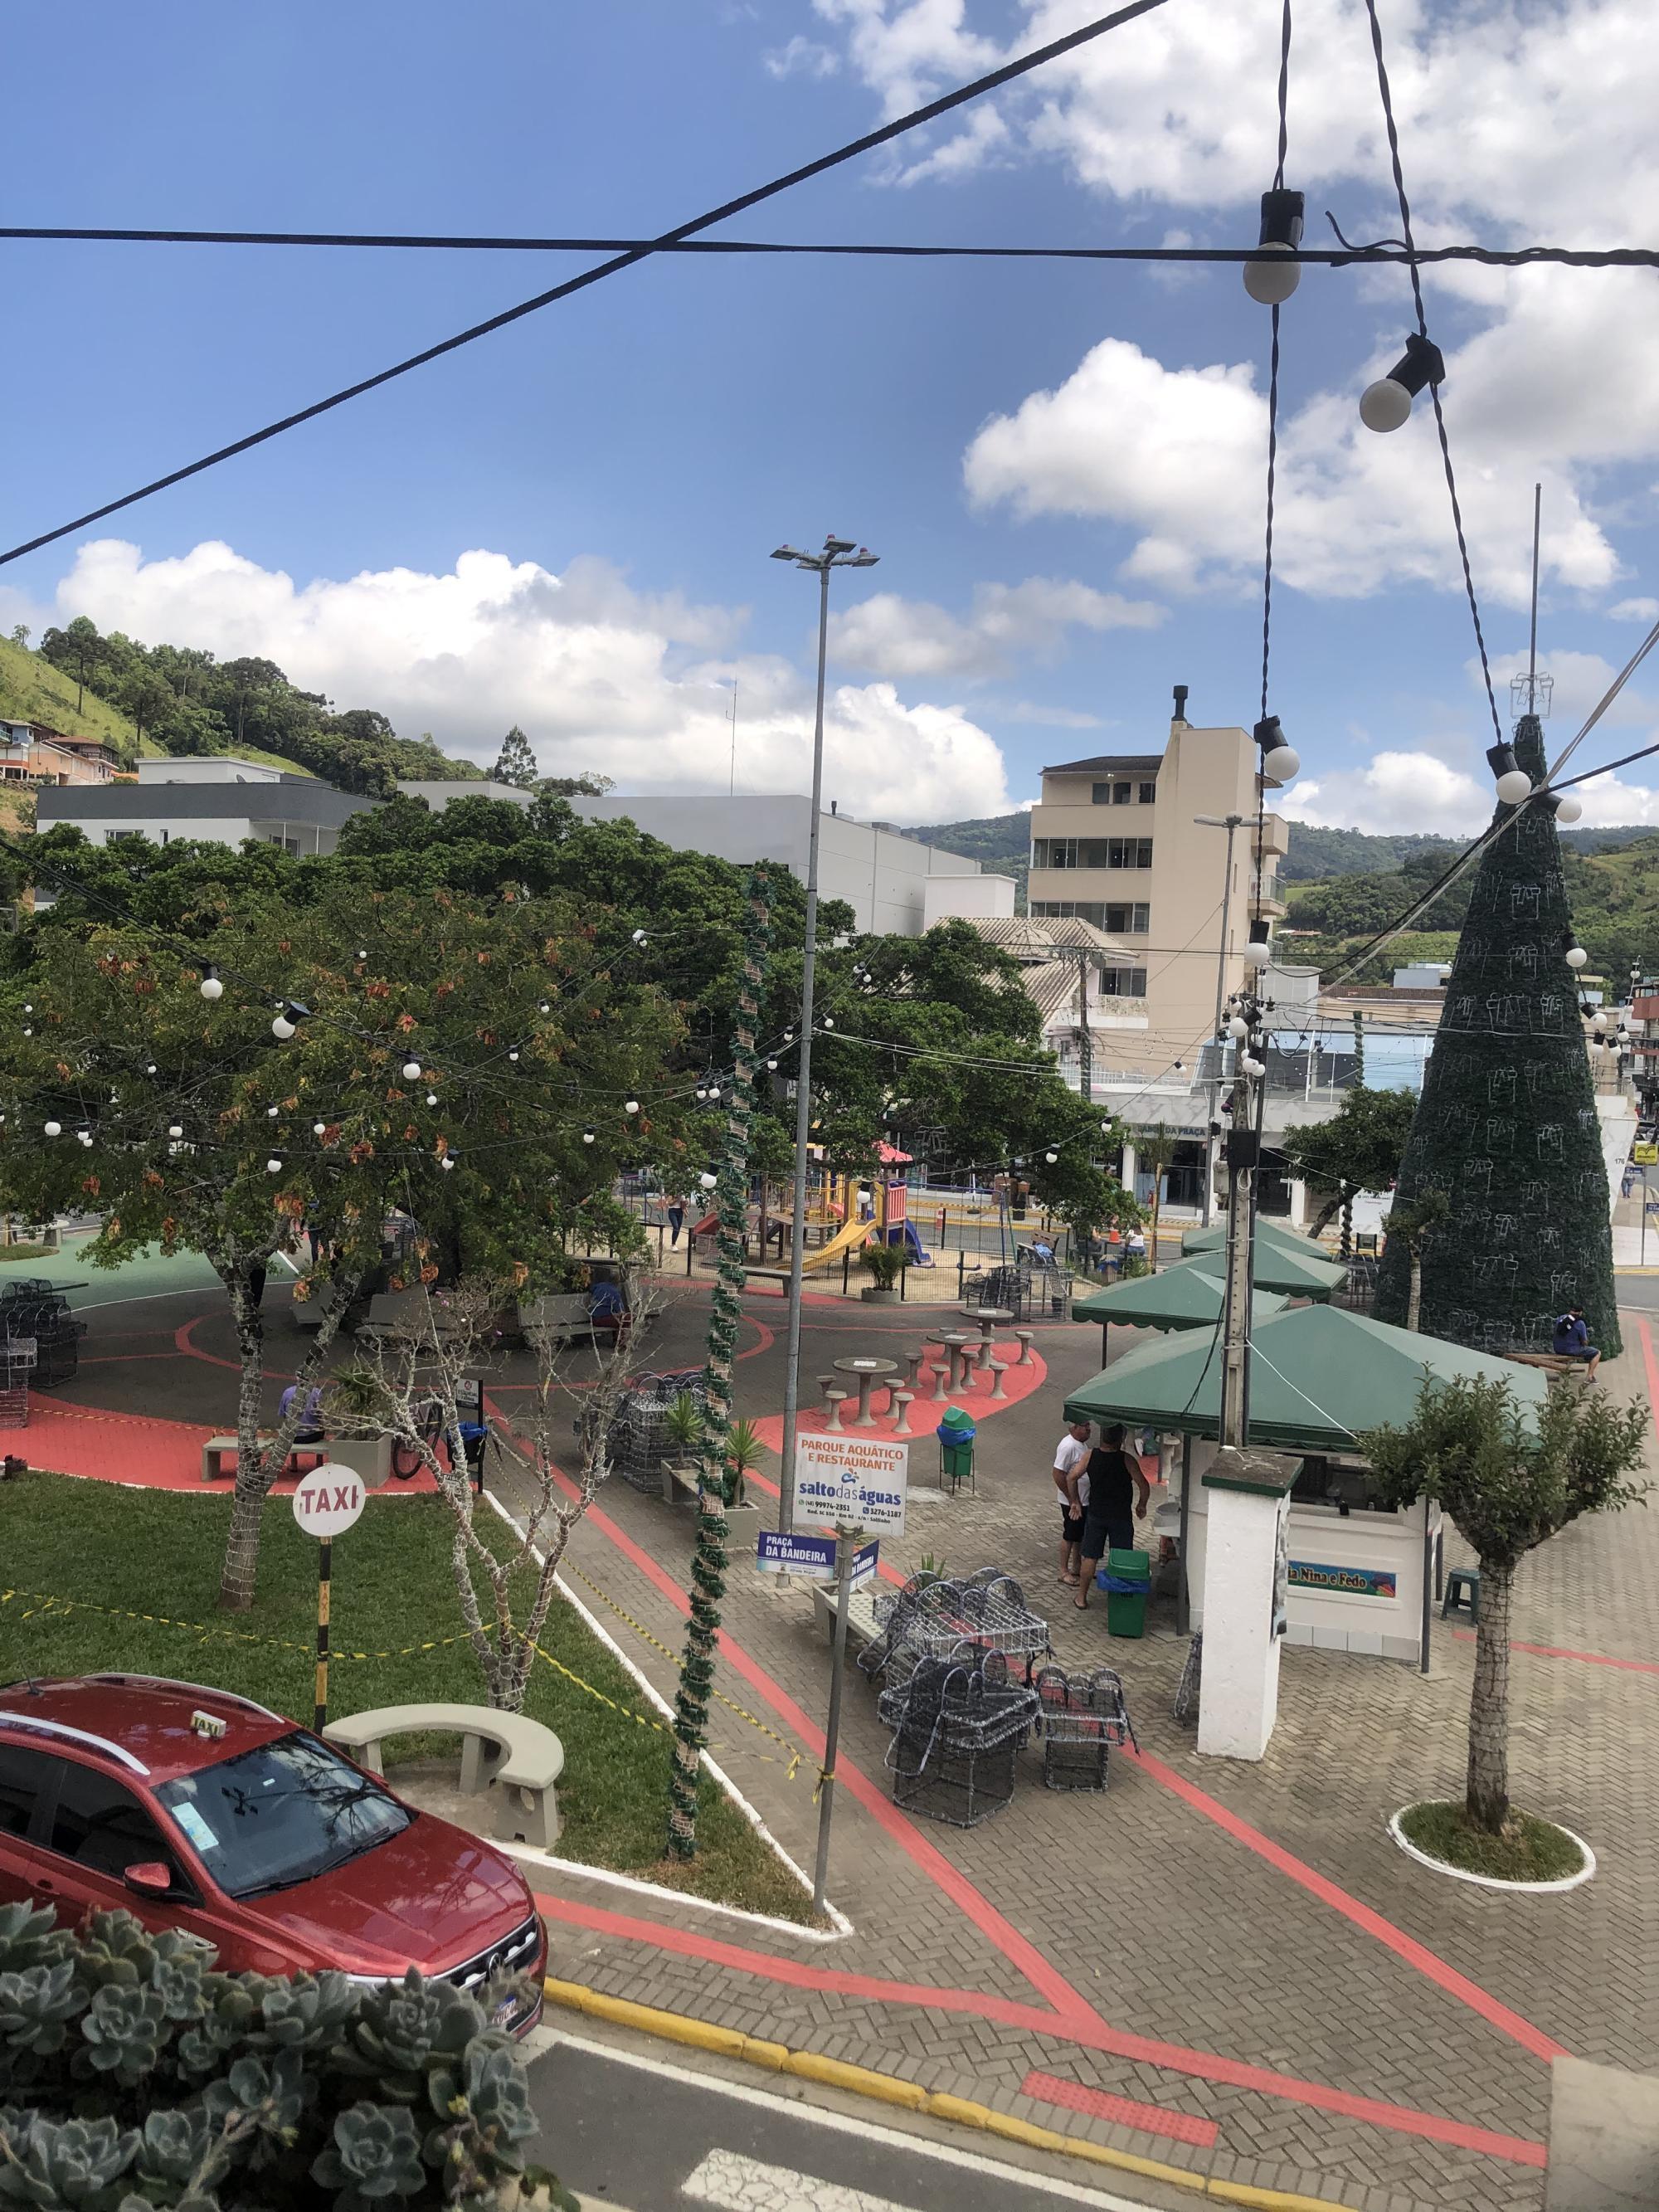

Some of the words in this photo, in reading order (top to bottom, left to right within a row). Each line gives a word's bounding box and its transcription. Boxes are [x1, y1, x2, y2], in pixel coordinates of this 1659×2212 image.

[1178, 1128, 1206, 1137] PRAÇA
[801, 1439, 846, 1452] PARQUE
[848, 1444, 904, 1460] AQUÁTICO
[808, 1453, 815, 1462] E
[817, 1454, 896, 1472] RESTAURANTE
[300, 1485, 358, 1514] TAXI
[815, 1502, 850, 1512] 99974-2351
[870, 1508, 902, 1518] 3276-1187
[766, 1536, 792, 1548] PRAÇA
[766, 1546, 778, 1557] DA
[781, 1547, 826, 1563] BANDEIRA
[1300, 1566, 1327, 1584] Nina
[1330, 1574, 1337, 1584] e
[1338, 1572, 1367, 1589] Fedo
[194, 1717, 219, 1737] TAXI
